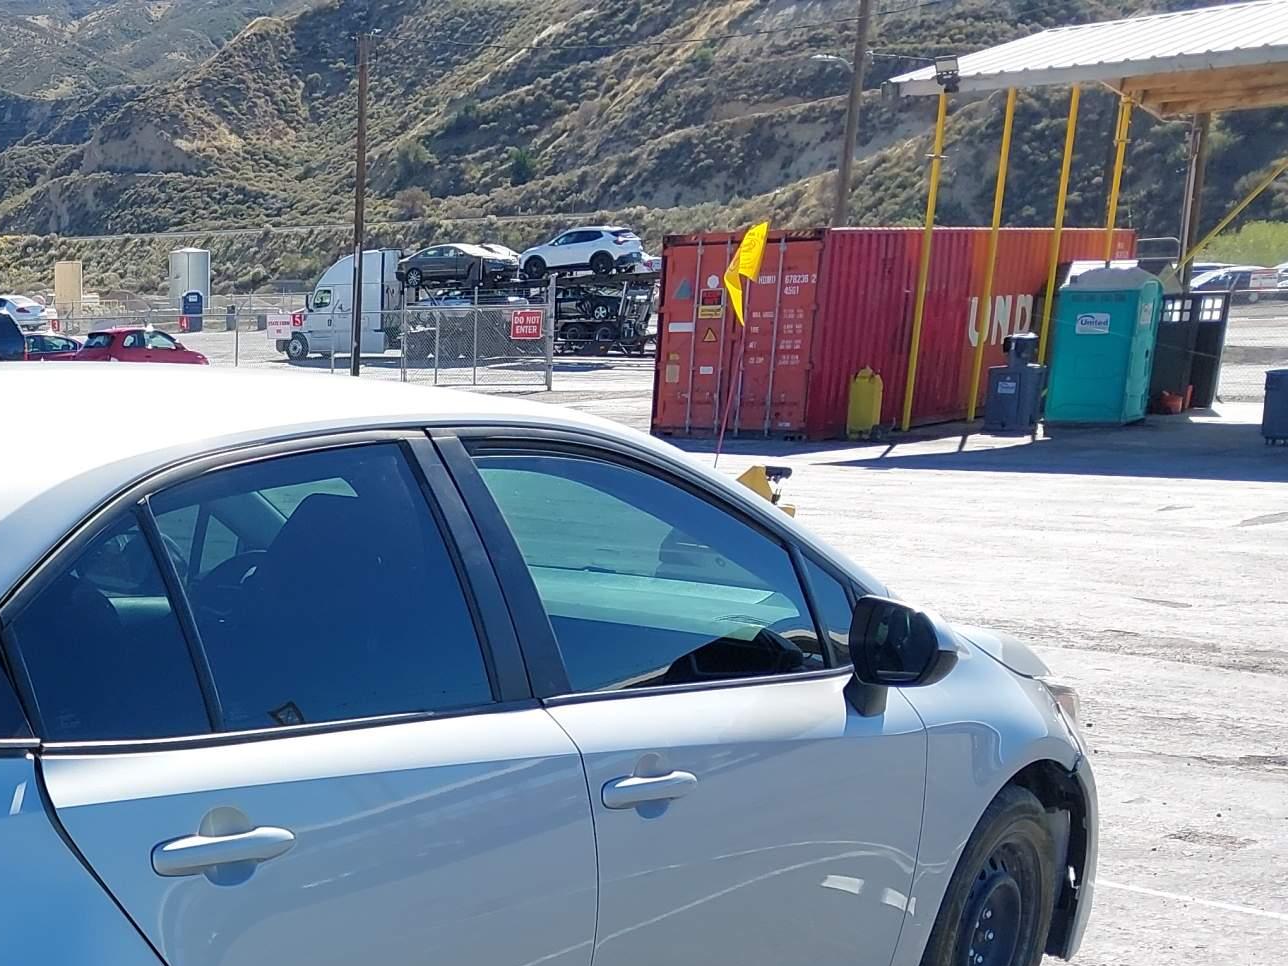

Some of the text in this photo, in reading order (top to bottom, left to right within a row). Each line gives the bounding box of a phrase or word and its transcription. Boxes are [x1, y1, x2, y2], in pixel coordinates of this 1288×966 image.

[810, 273, 817, 284] 2
[514, 315, 540, 324] DO NOT
[515, 325, 537, 334] ENTER
